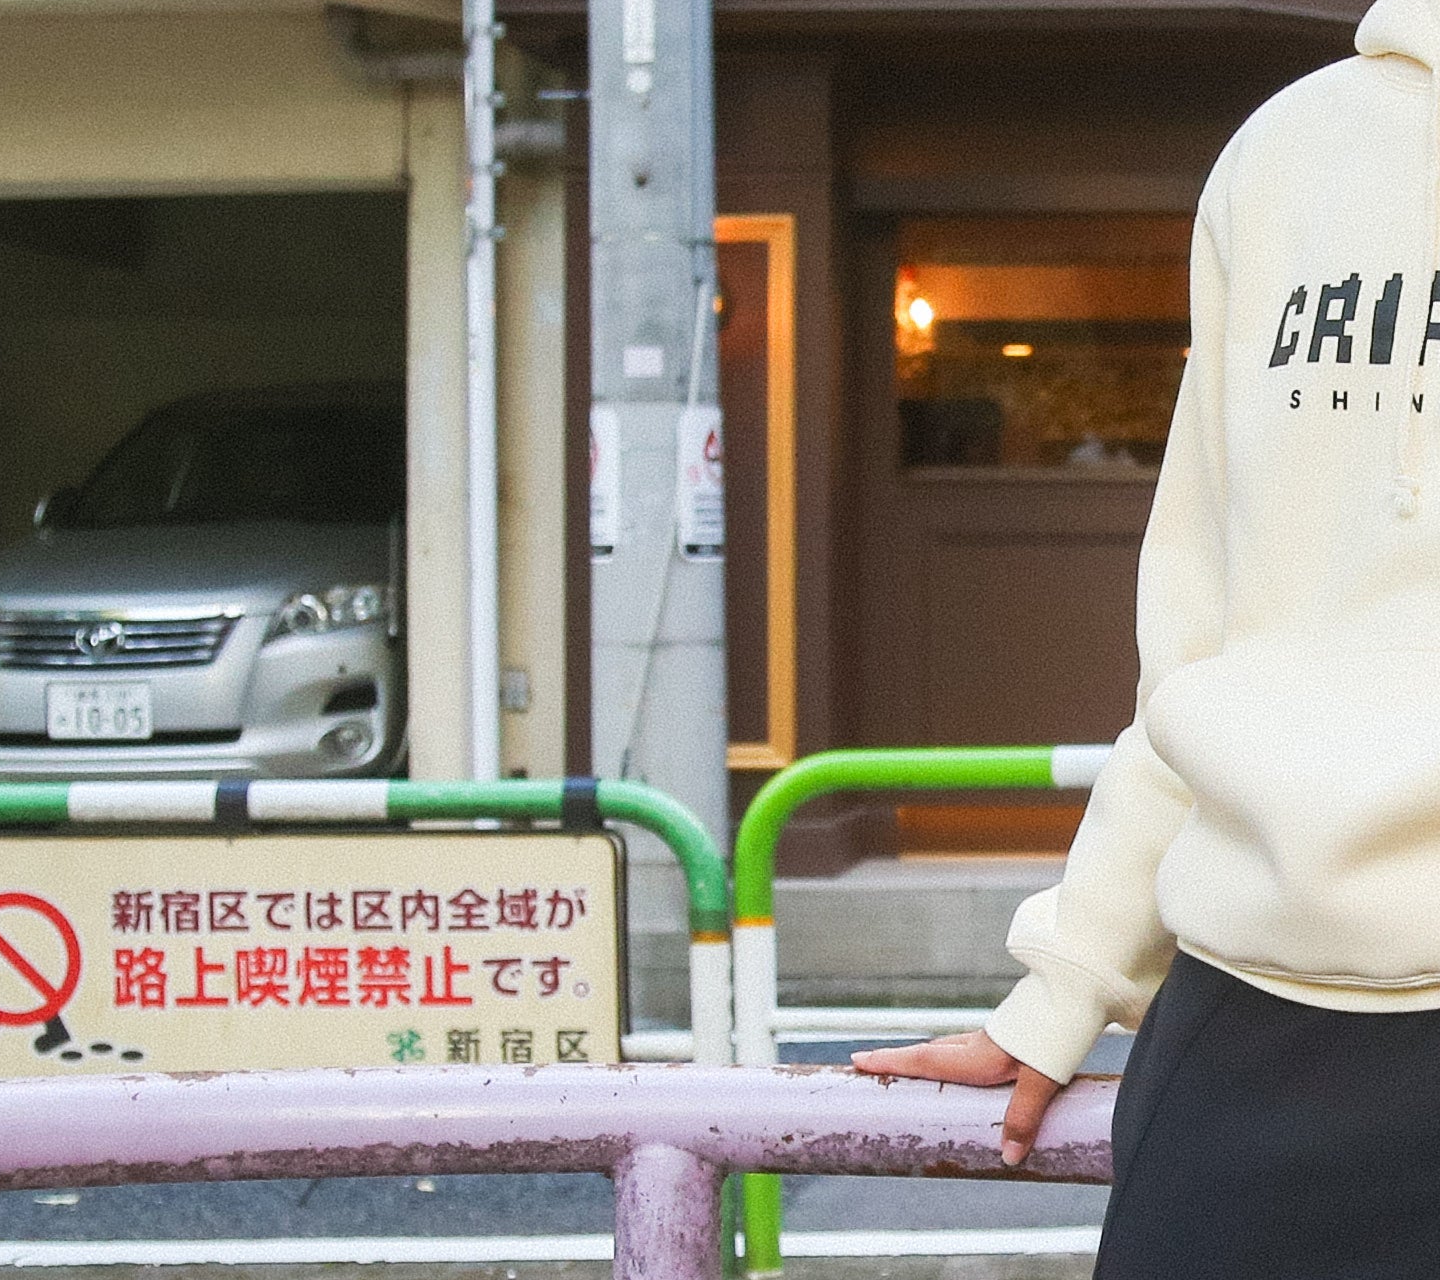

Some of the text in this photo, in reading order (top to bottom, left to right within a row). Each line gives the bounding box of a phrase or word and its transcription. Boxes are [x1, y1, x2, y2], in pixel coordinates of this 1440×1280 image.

[112, 889, 586, 933] 新宿区では区内全域が
[113, 944, 589, 1009] 路上喫煙禁止です。
[447, 1028, 589, 1064] 新宿区
